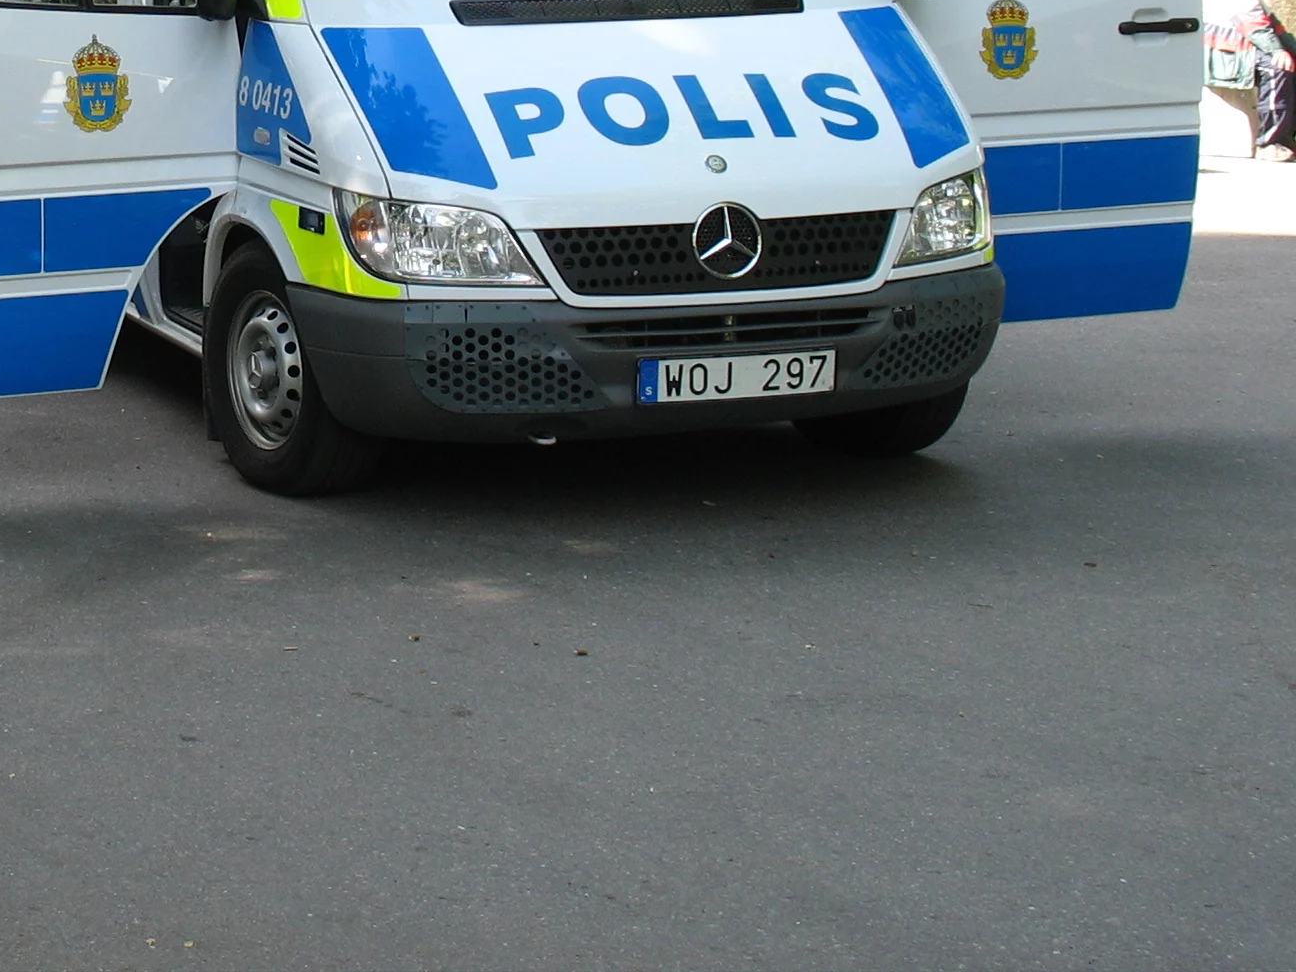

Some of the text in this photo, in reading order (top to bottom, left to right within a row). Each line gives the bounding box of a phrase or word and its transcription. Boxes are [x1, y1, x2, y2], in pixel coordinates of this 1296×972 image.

[252, 79, 293, 119] 0413
[484, 72, 880, 159] POLIS
[665, 361, 733, 397] WOJ
[762, 354, 828, 392] 297
